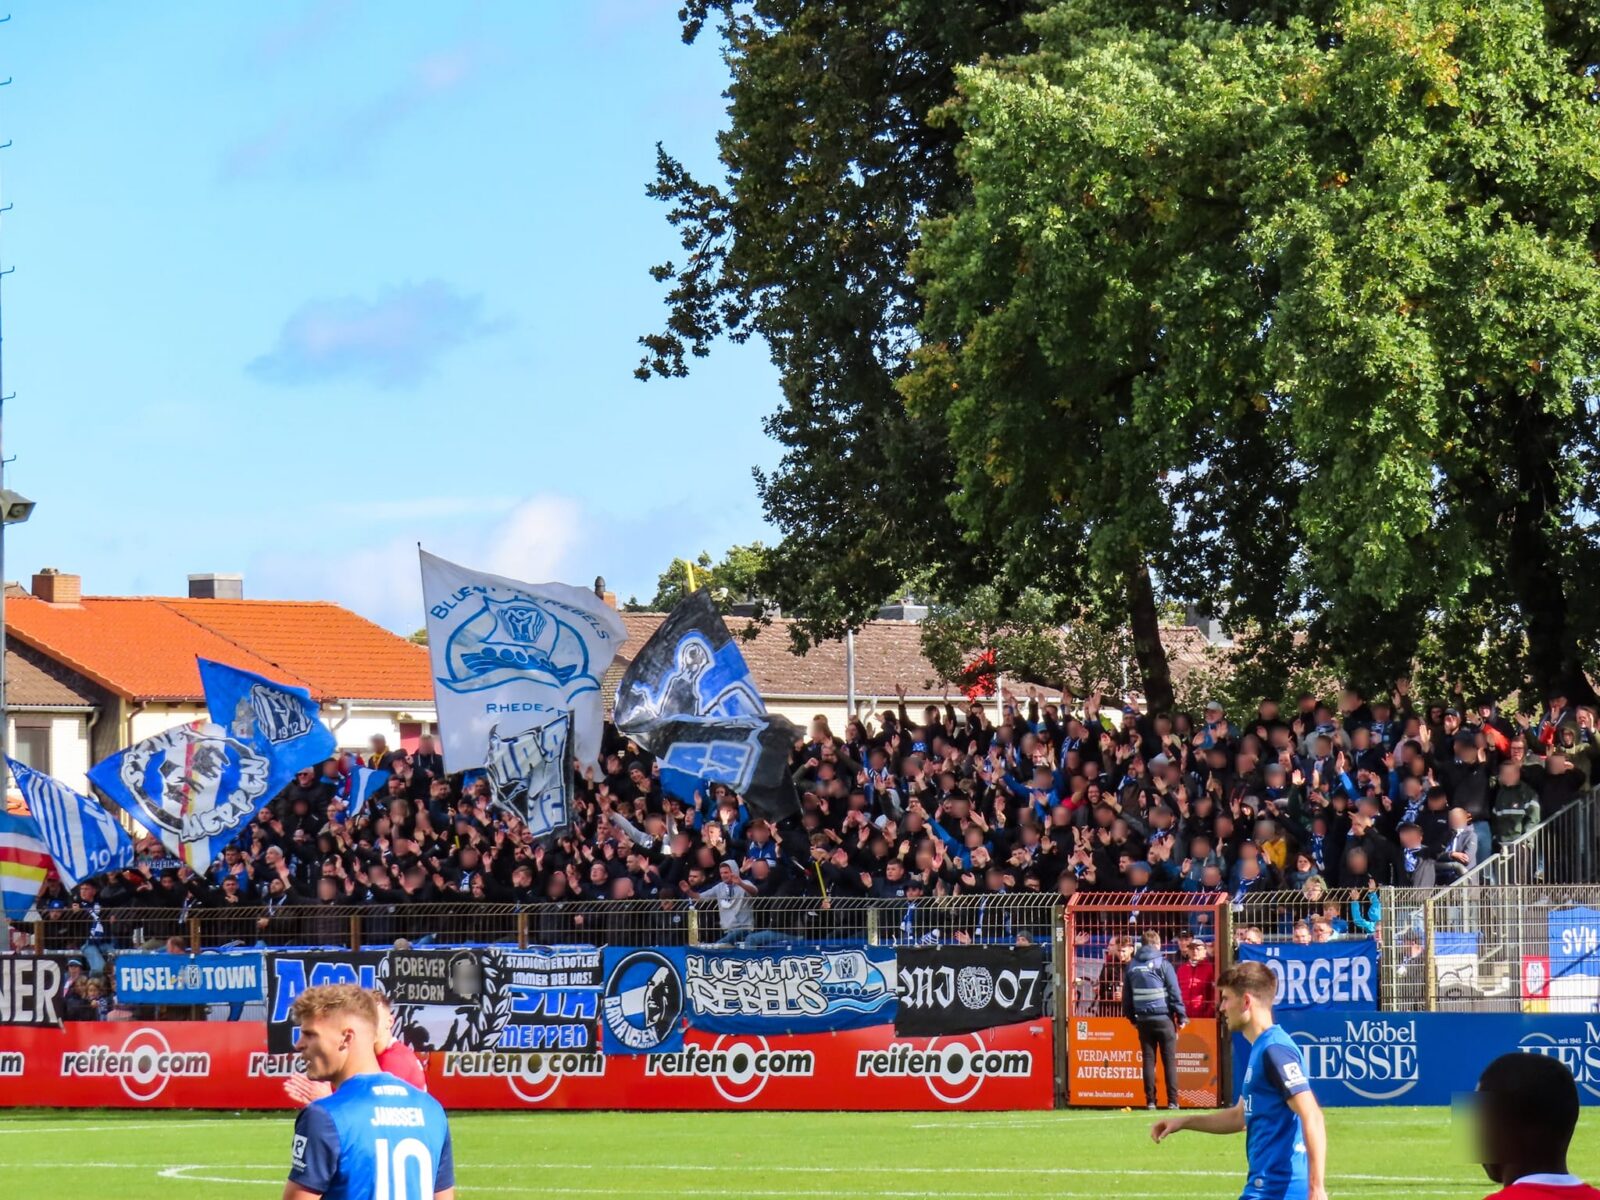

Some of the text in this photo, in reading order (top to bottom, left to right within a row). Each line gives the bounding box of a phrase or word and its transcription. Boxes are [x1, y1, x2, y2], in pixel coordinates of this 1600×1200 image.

[120, 965, 256, 992] FUSEL TOWN
[394, 956, 446, 978] FOREVER
[512, 971, 549, 986] IMMER
[550, 972, 568, 985] BEI
[1243, 947, 1374, 1005] ÖRGER
[407, 980, 445, 1001] BJÖRN
[994, 968, 1040, 1011] 07
[1344, 1020, 1418, 1043] Möbel
[1076, 1050, 1133, 1062] VERDAMMT
[375, 1137, 434, 1200] 10
